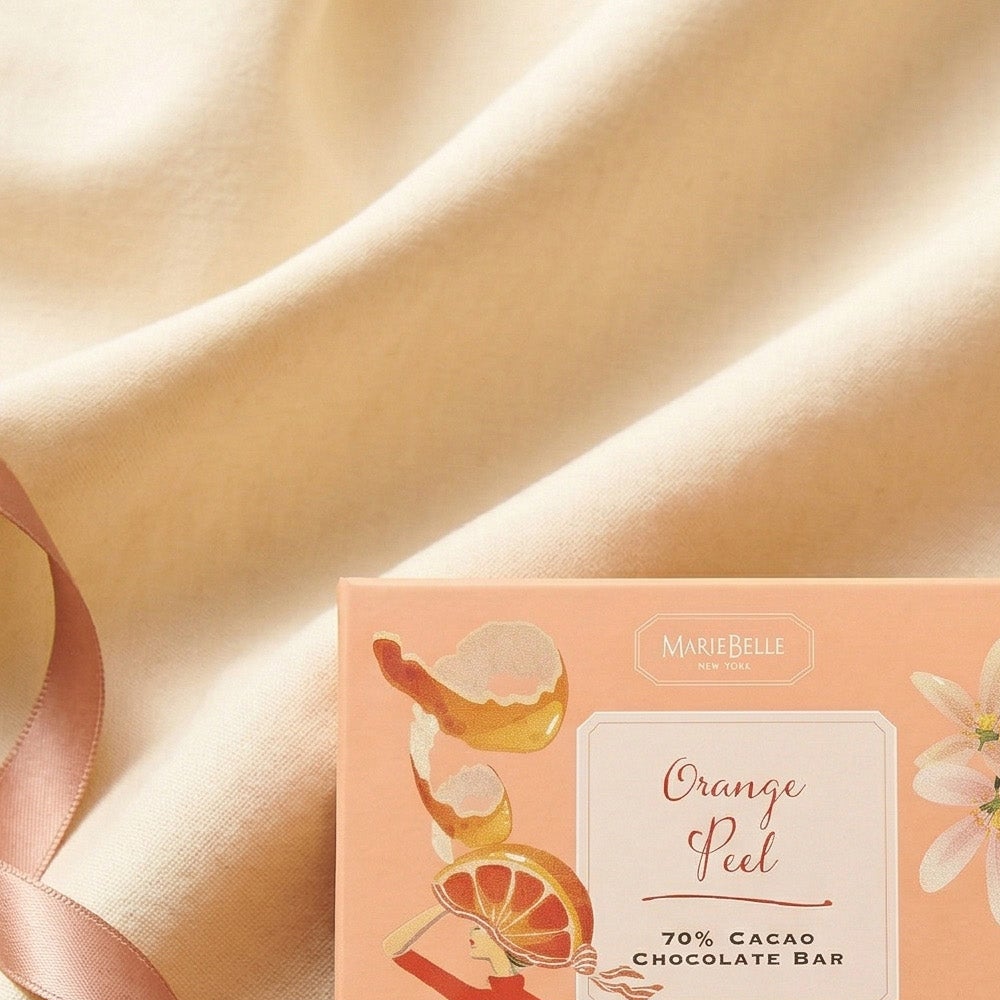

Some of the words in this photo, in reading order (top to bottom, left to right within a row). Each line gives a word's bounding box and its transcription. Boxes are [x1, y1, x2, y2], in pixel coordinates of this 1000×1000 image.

[697, 661, 720, 672] NEW
[663, 757, 806, 830] Orange
[687, 816, 779, 882] Peel
[661, 930, 715, 948] 70%
